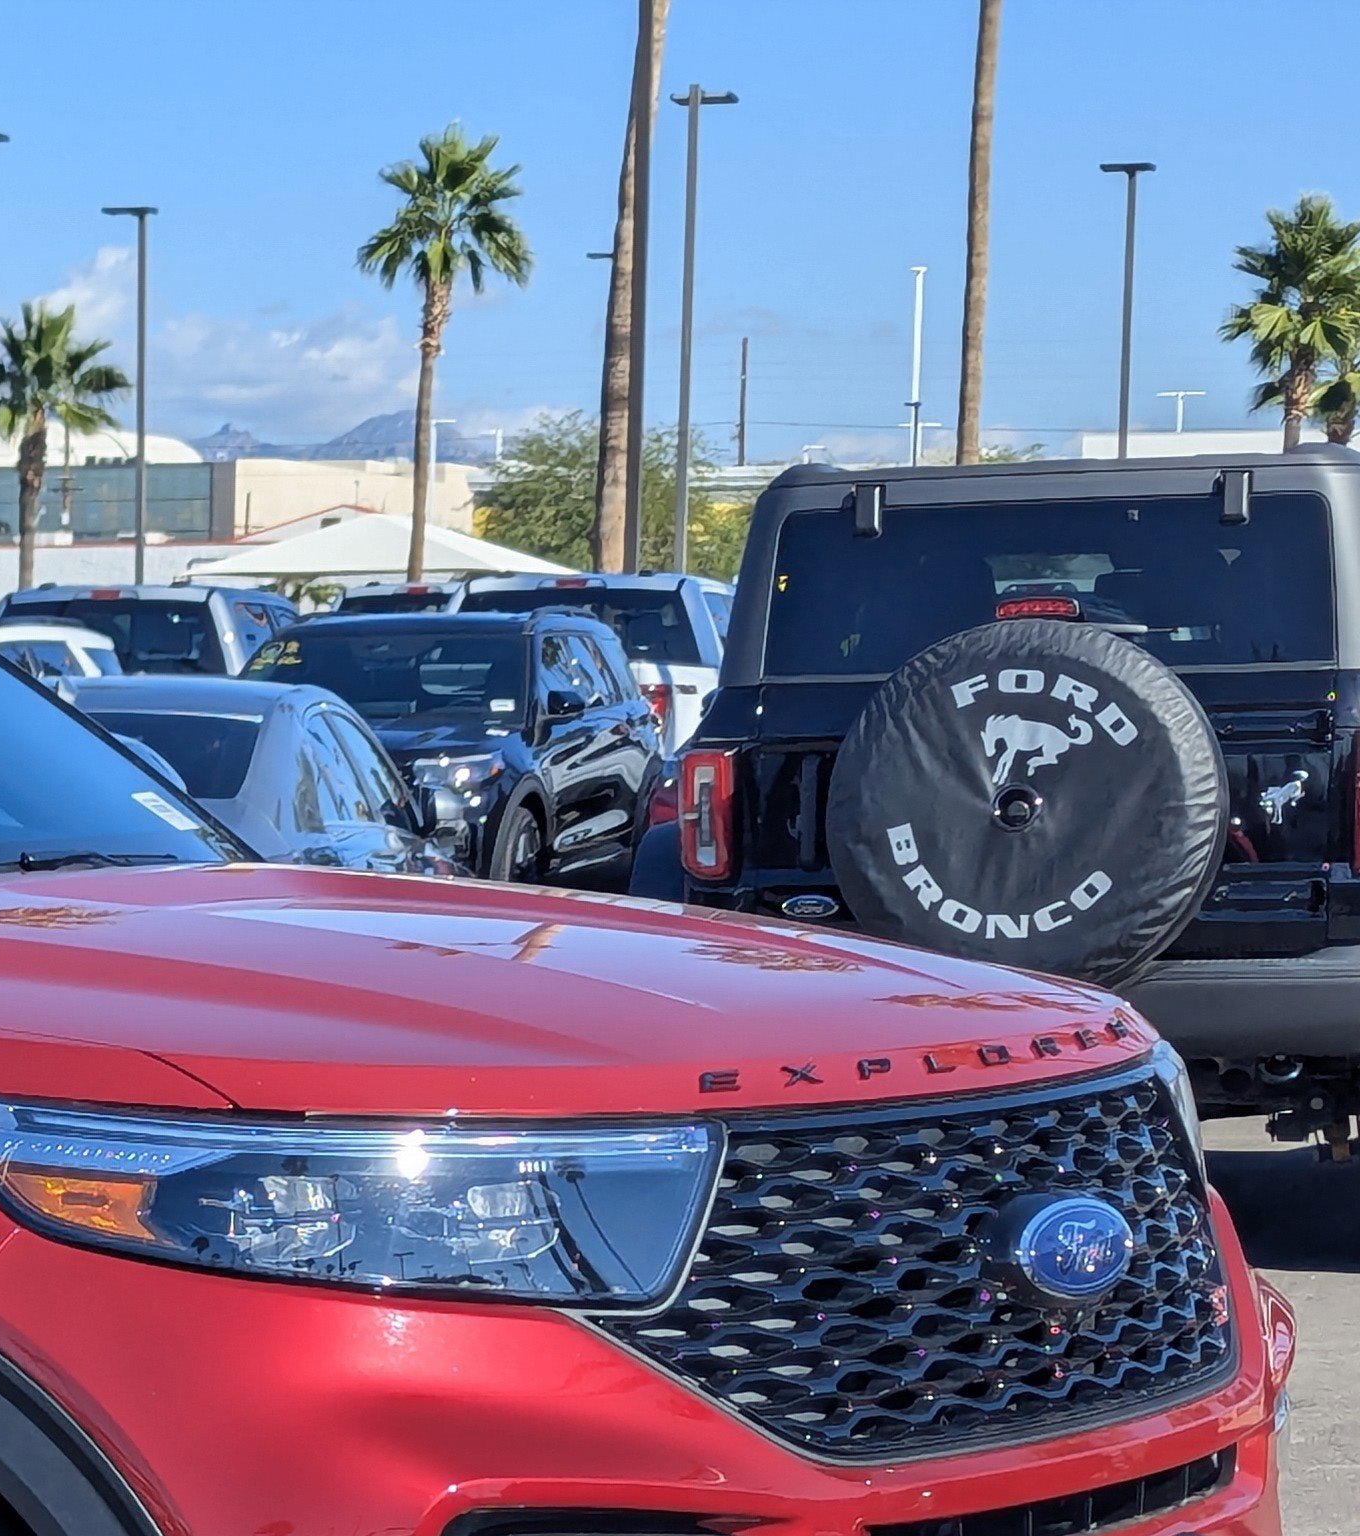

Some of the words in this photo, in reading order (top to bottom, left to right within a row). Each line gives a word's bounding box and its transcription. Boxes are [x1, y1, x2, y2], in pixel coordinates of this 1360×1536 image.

[950, 668, 1139, 747] FORD
[886, 822, 1114, 940] BRONCO
[698, 1017, 1131, 1095] EXPLORER
